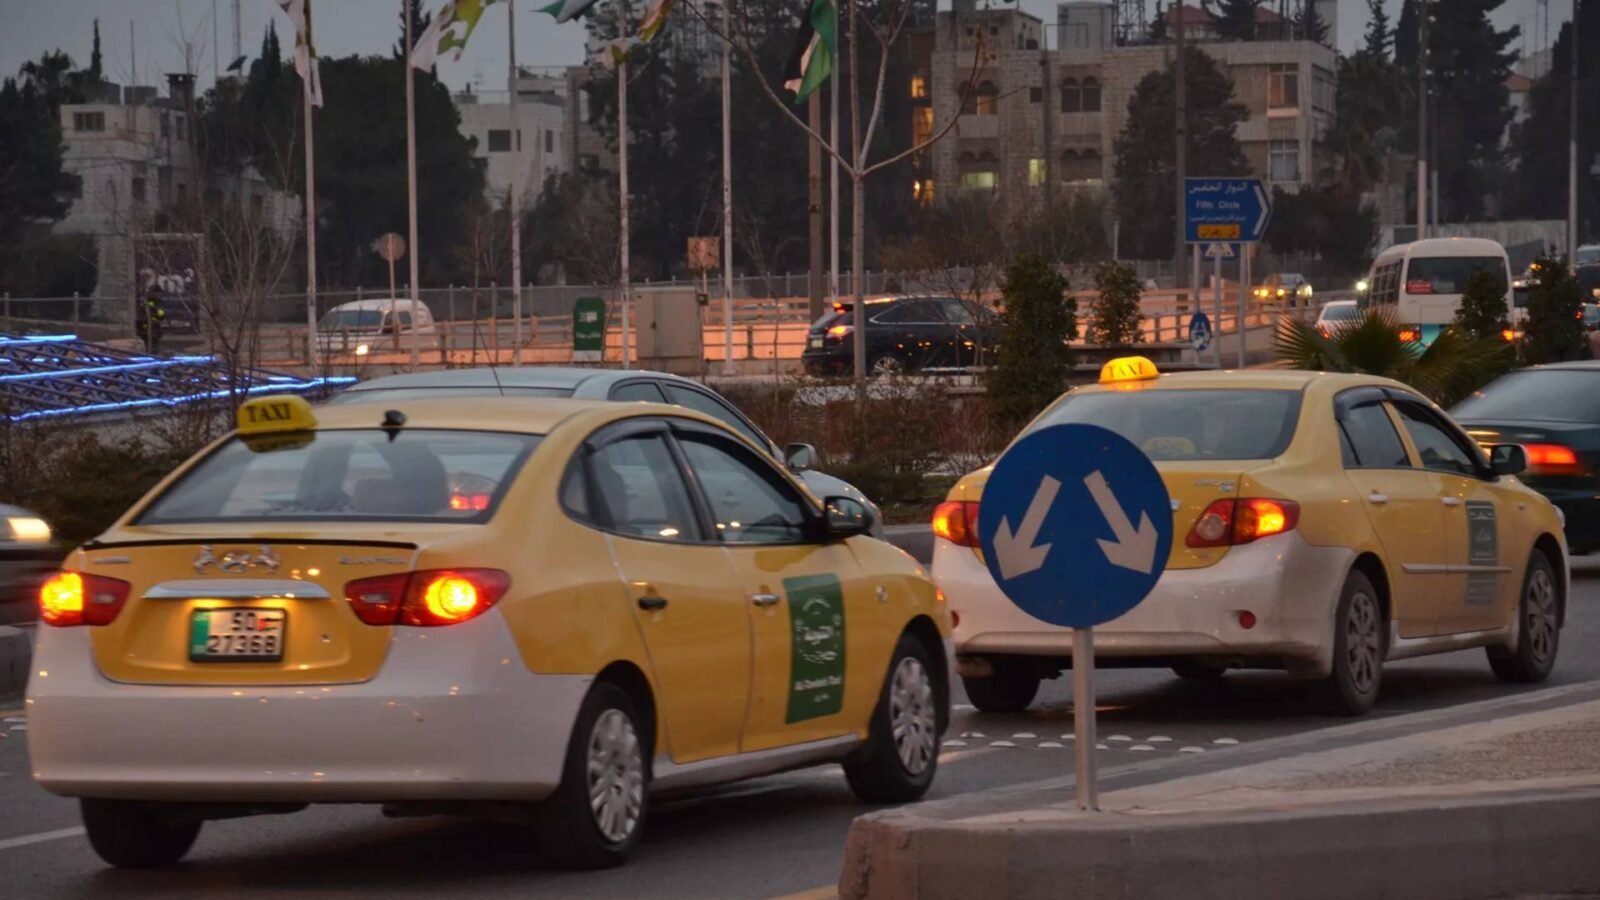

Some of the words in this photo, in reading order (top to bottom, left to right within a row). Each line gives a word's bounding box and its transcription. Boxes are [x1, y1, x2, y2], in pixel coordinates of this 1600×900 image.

[1225, 182, 1248, 194] الدوار
[1196, 200, 1214, 209] Fifth
[1218, 200, 1240, 209] Circle
[1107, 362, 1143, 378] TAXI
[245, 403, 291, 422] TAXI
[231, 612, 256, 630] 50
[206, 635, 276, 653] 27368
